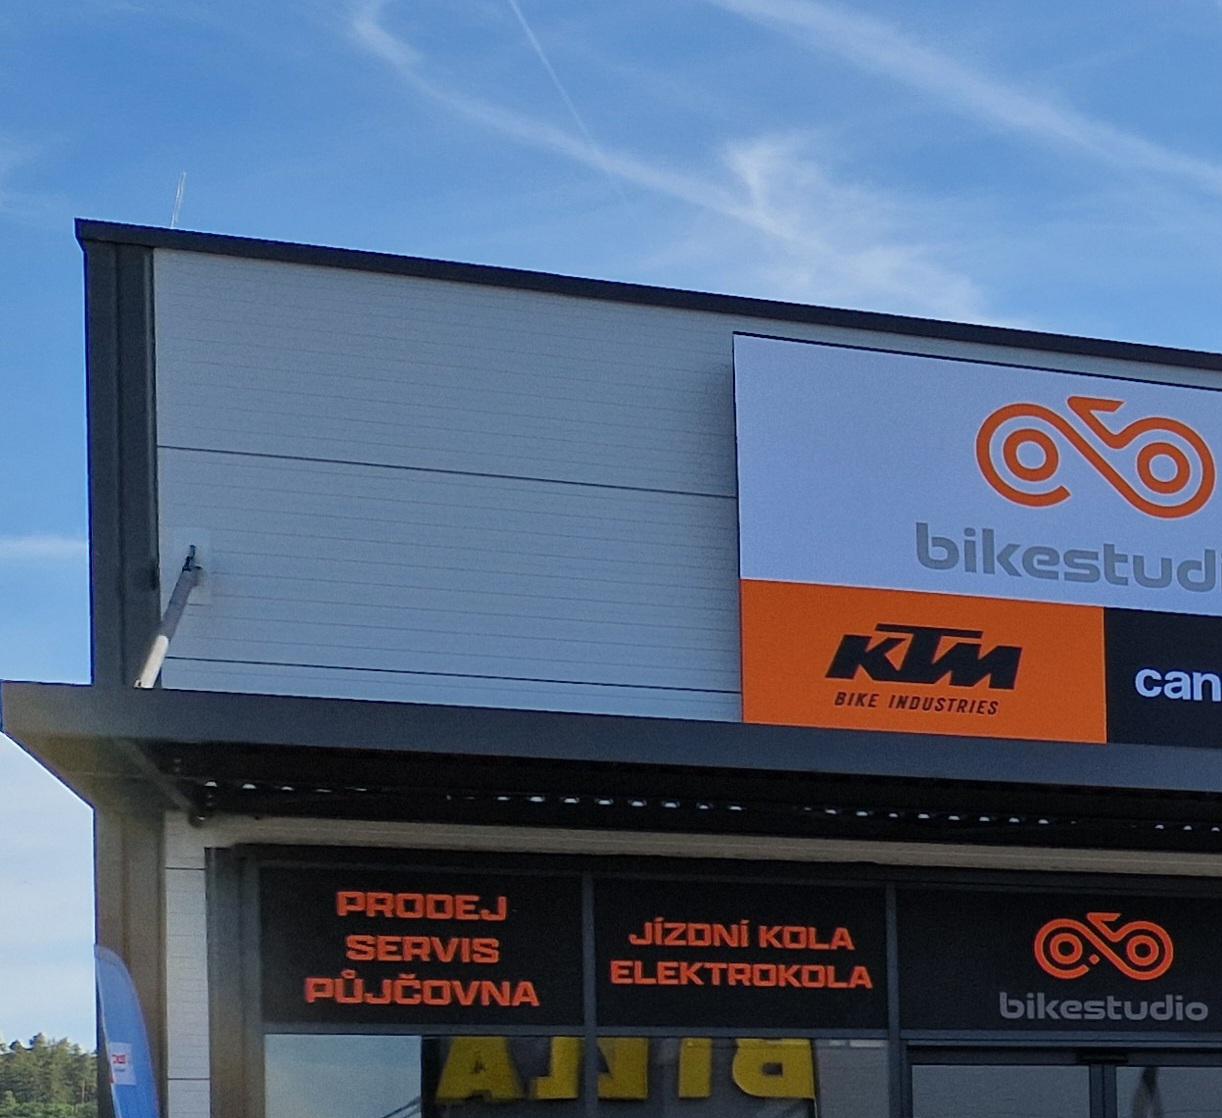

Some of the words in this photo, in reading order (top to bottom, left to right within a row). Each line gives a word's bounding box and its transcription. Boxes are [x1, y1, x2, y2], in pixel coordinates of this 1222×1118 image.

[825, 623, 1023, 690] KTM
[834, 691, 879, 708] BIKE
[888, 694, 999, 716] INDUSTRIES
[336, 891, 508, 921] PRODEJ
[628, 916, 750, 948] JÍZDNÍ
[758, 925, 855, 950] KOLA
[345, 934, 500, 964] SERVIS
[304, 969, 541, 1007] PŮJČOVNA
[610, 959, 873, 989] ELEKTROKOLA
[1000, 991, 1209, 1022] bikestudio
